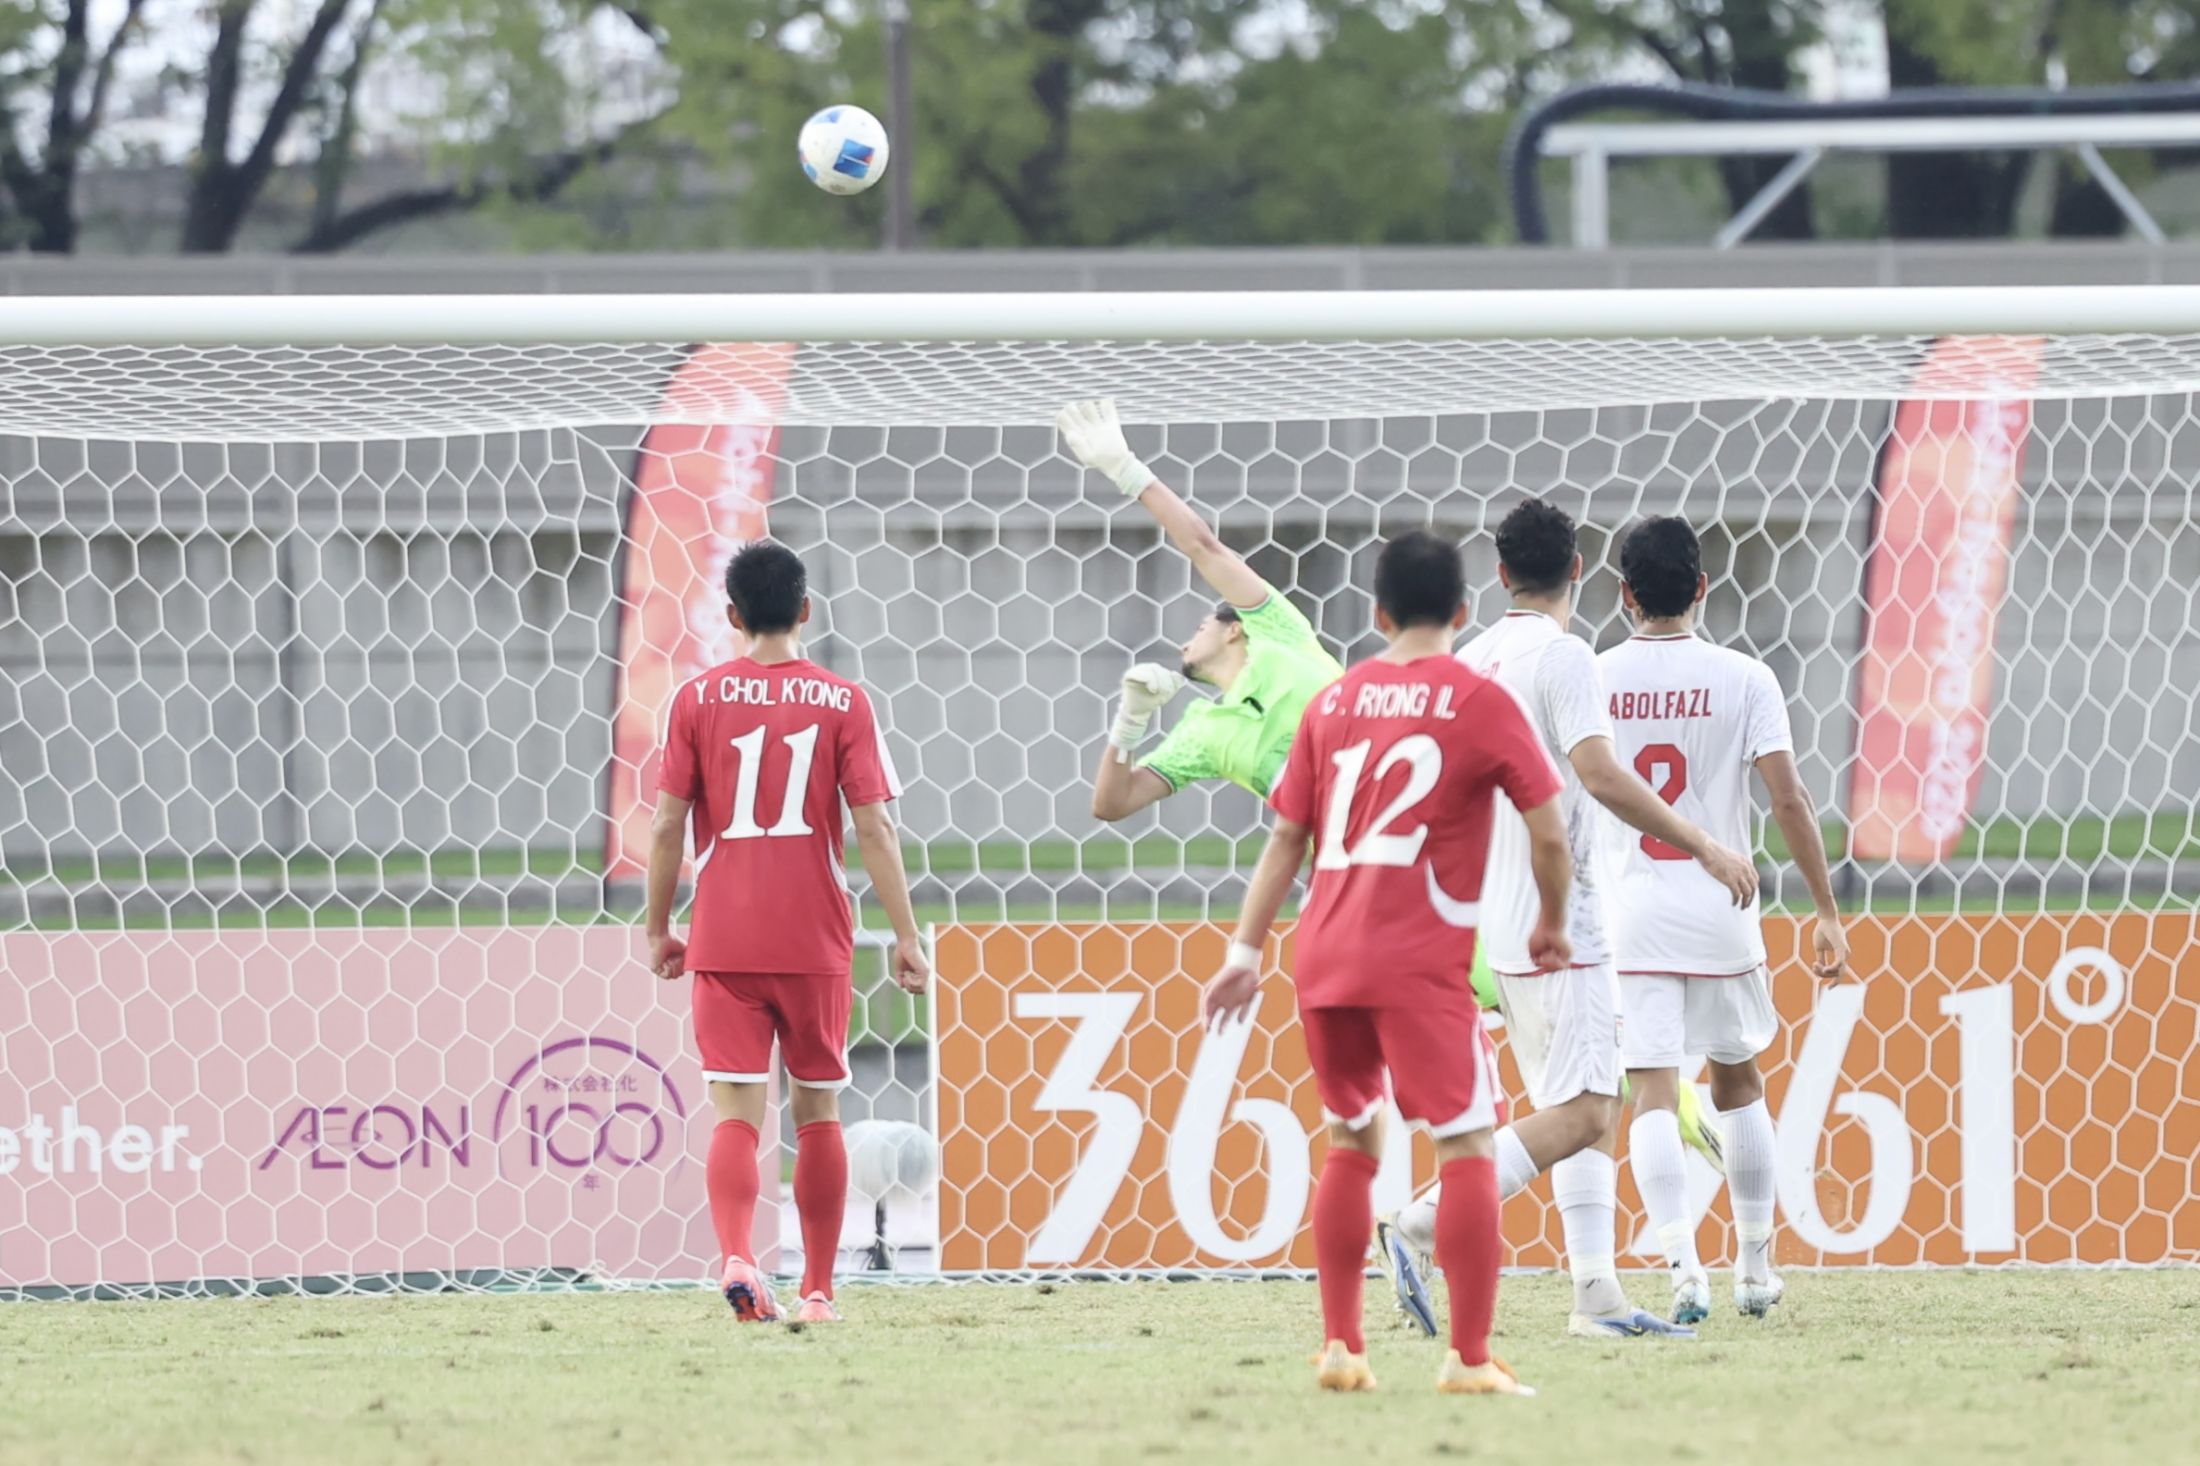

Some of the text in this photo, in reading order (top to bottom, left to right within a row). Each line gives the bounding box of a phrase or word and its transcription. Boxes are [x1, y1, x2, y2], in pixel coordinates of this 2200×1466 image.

[694, 676, 852, 712] Y. CHOL KYONG
[1353, 682, 1431, 719] RYONG
[1432, 684, 1456, 720] IL
[1609, 688, 1712, 720] ABOLFAZL
[721, 723, 819, 840] 11
[1315, 733, 1443, 870] 12
[526, 1102, 664, 1168] 100
